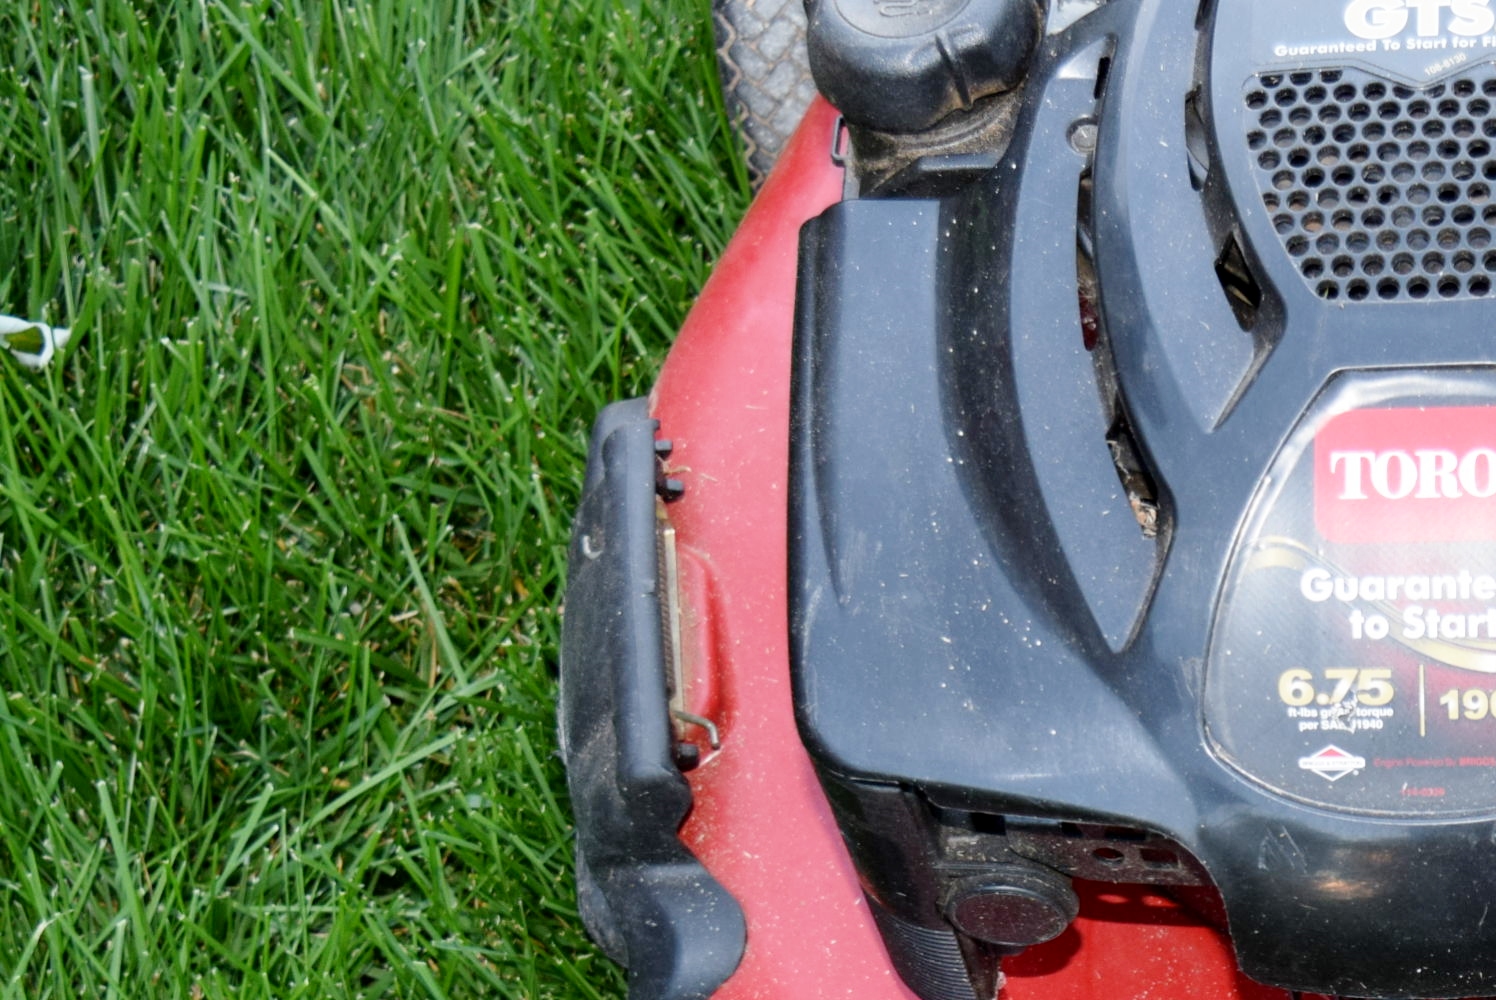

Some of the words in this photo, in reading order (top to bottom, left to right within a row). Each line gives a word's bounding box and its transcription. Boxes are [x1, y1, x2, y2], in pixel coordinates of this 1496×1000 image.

[1274, 40, 1377, 57] Guaranteed
[1382, 38, 1400, 51] To
[1406, 36, 1448, 50] Start
[1453, 35, 1477, 48] for
[1349, 607, 1390, 640] to
[1277, 667, 1395, 707] 6.75
[1356, 707, 1394, 719] torque
[1298, 721, 1319, 732] per
